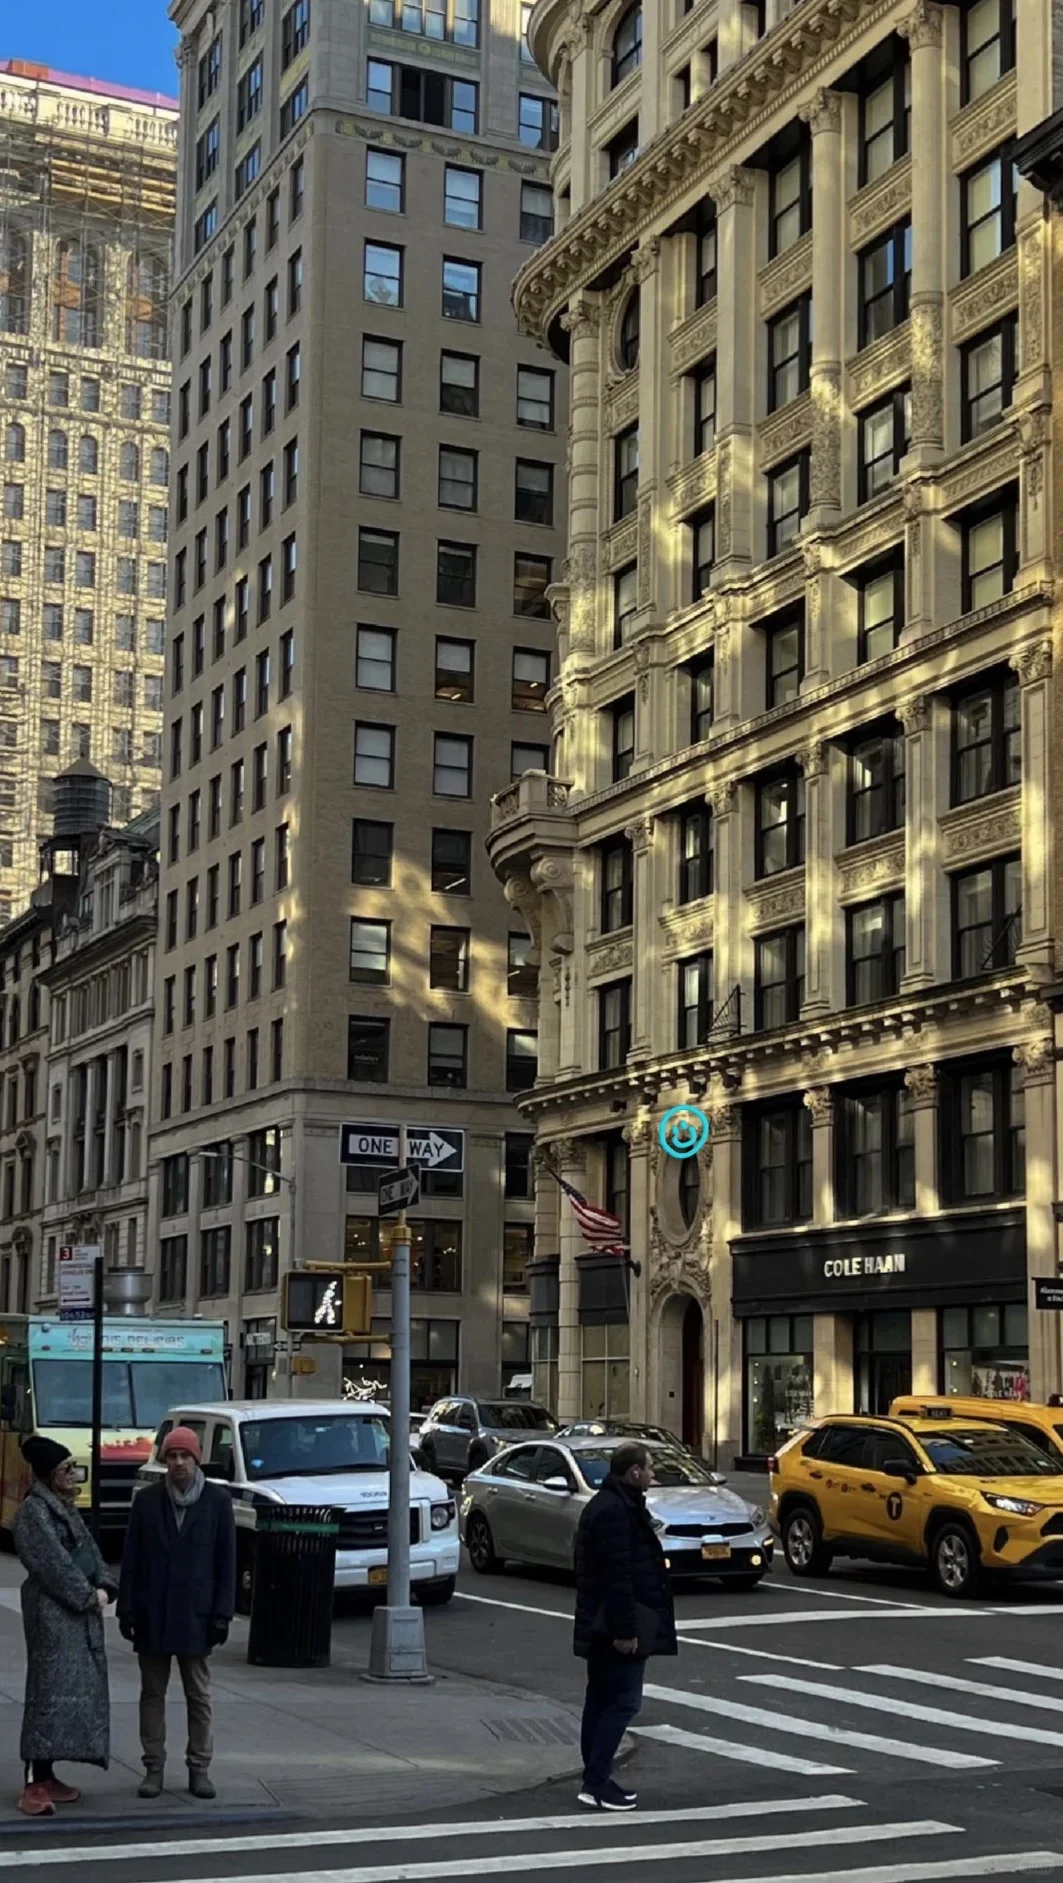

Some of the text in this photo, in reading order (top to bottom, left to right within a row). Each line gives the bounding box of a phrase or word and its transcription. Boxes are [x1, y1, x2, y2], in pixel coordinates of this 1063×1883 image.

[358, 1137, 445, 1158] ONE WAY
[62, 1248, 70, 1260] 3
[824, 1253, 905, 1277] COLE HAAN
[890, 1497, 900, 1517] T
